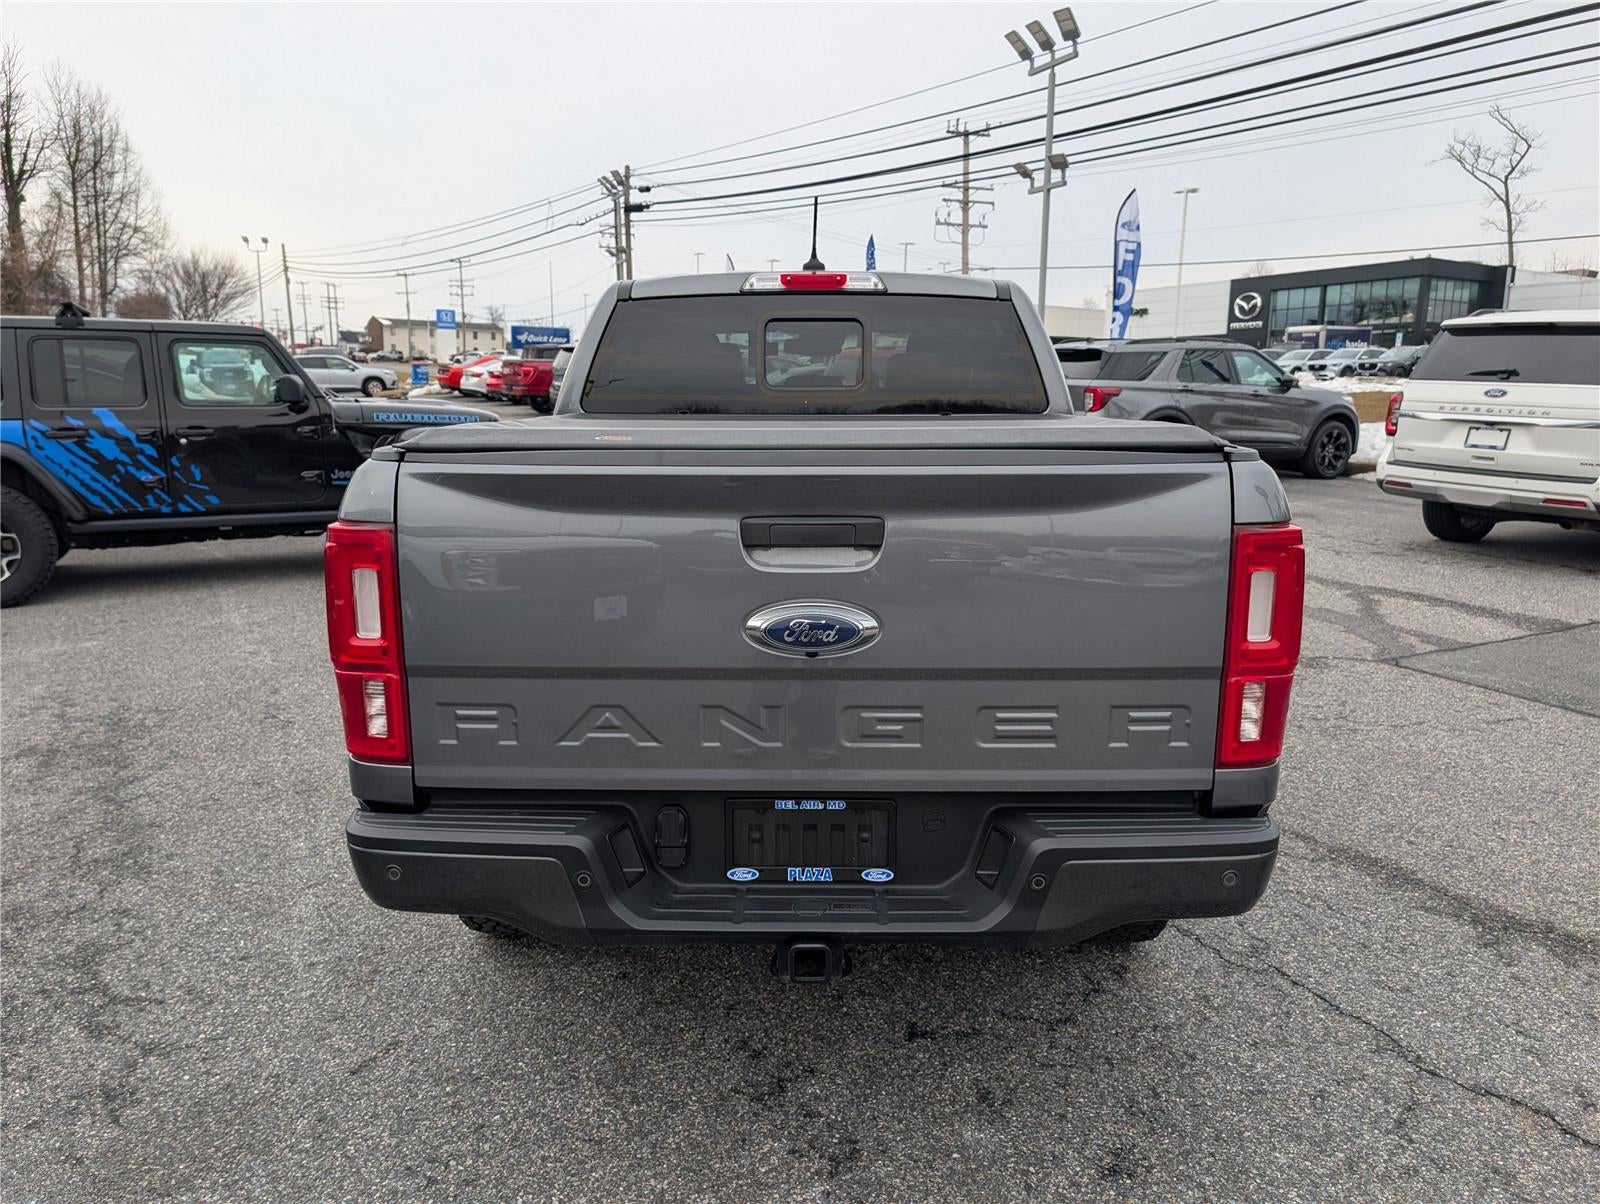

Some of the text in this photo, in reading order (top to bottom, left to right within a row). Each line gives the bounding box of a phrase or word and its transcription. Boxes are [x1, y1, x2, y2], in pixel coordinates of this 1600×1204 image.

[527, 334, 548, 343] Quick
[1438, 405, 1551, 416] EXPEDITION
[373, 412, 480, 423] RUBICON
[331, 468, 352, 479] Jee
[783, 618, 840, 643] Ford
[436, 703, 1193, 749] RANGER
[774, 799, 798, 810] BEL
[826, 799, 846, 810] MD
[787, 867, 833, 882] PLAZA
